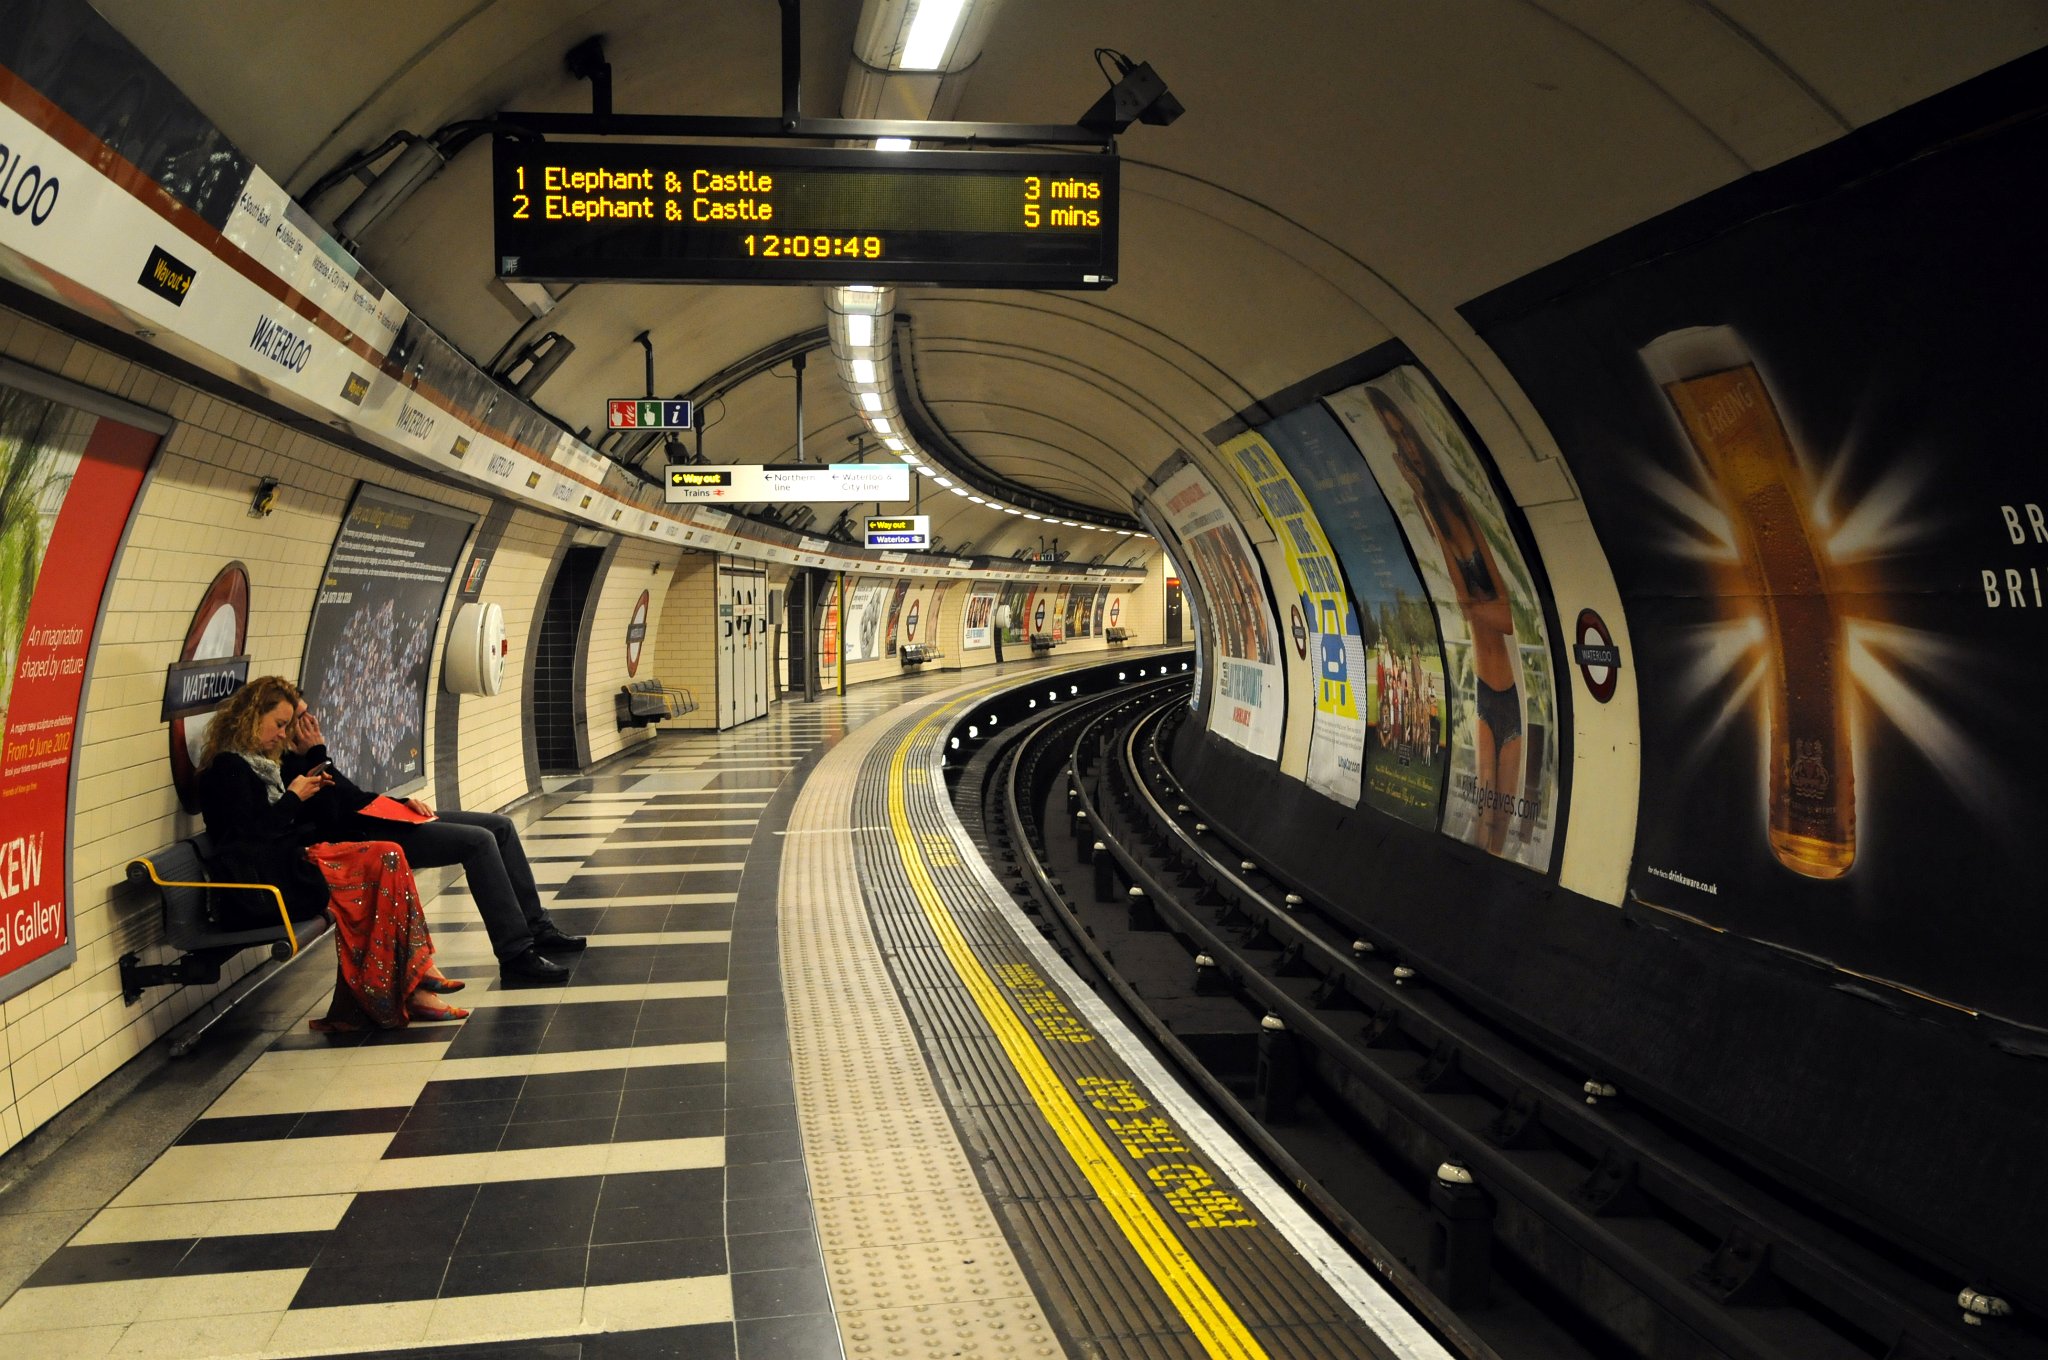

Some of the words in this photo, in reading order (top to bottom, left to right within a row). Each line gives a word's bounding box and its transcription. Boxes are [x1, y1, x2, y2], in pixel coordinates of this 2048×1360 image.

[516, 167, 526, 189] 1
[545, 168, 654, 192] Elephant
[665, 172, 681, 192] &
[693, 170, 772, 192] Castle
[1025, 177, 1040, 199] 3
[1051, 179, 1100, 199] mins
[257, 210, 271, 227] Bank
[513, 196, 529, 218] 2
[545, 196, 654, 221] Elephant
[665, 200, 681, 220] &
[693, 198, 772, 220] Castle
[1025, 206, 1040, 227] 5
[1051, 207, 1100, 227] mins
[744, 235, 881, 258] 12:09:49
[153, 258, 170, 288] Way
[168, 273, 183, 290] out
[250, 314, 312, 373] WATERLOO
[396, 403, 435, 440] WATERLOO
[683, 473, 704, 484] Way
[703, 474, 721, 484] out
[775, 473, 816, 481] Northern
[775, 483, 790, 491] line
[842, 483, 860, 492] City
[863, 483, 879, 491] line
[843, 473, 884, 481] Waterloo
[684, 489, 710, 497] Trains
[877, 521, 892, 530] Way
[877, 535, 910, 543] Waterloo
[2001, 504, 2048, 545] BR
[27, 625, 41, 647] An
[40, 624, 83, 651] imagination
[20, 654, 51, 683] shaped
[49, 654, 61, 681] by
[60, 656, 83, 675] nature
[1582, 650, 1612, 662] WATERLOO
[182, 670, 235, 703] WATERLOO
[7, 742, 28, 762] From
[28, 738, 35, 758] 9
[35, 738, 53, 757] June
[53, 731, 71, 753] 2012
[1472, 775, 1539, 822] figleaves.com
[1668, 870, 1718, 895] drinkaware.co.uk
[14, 900, 61, 946] Gallery
[1076, 1076, 1150, 1113] GAP
[1106, 1117, 1191, 1160] THE
[1147, 1164, 1258, 1229] MIND
